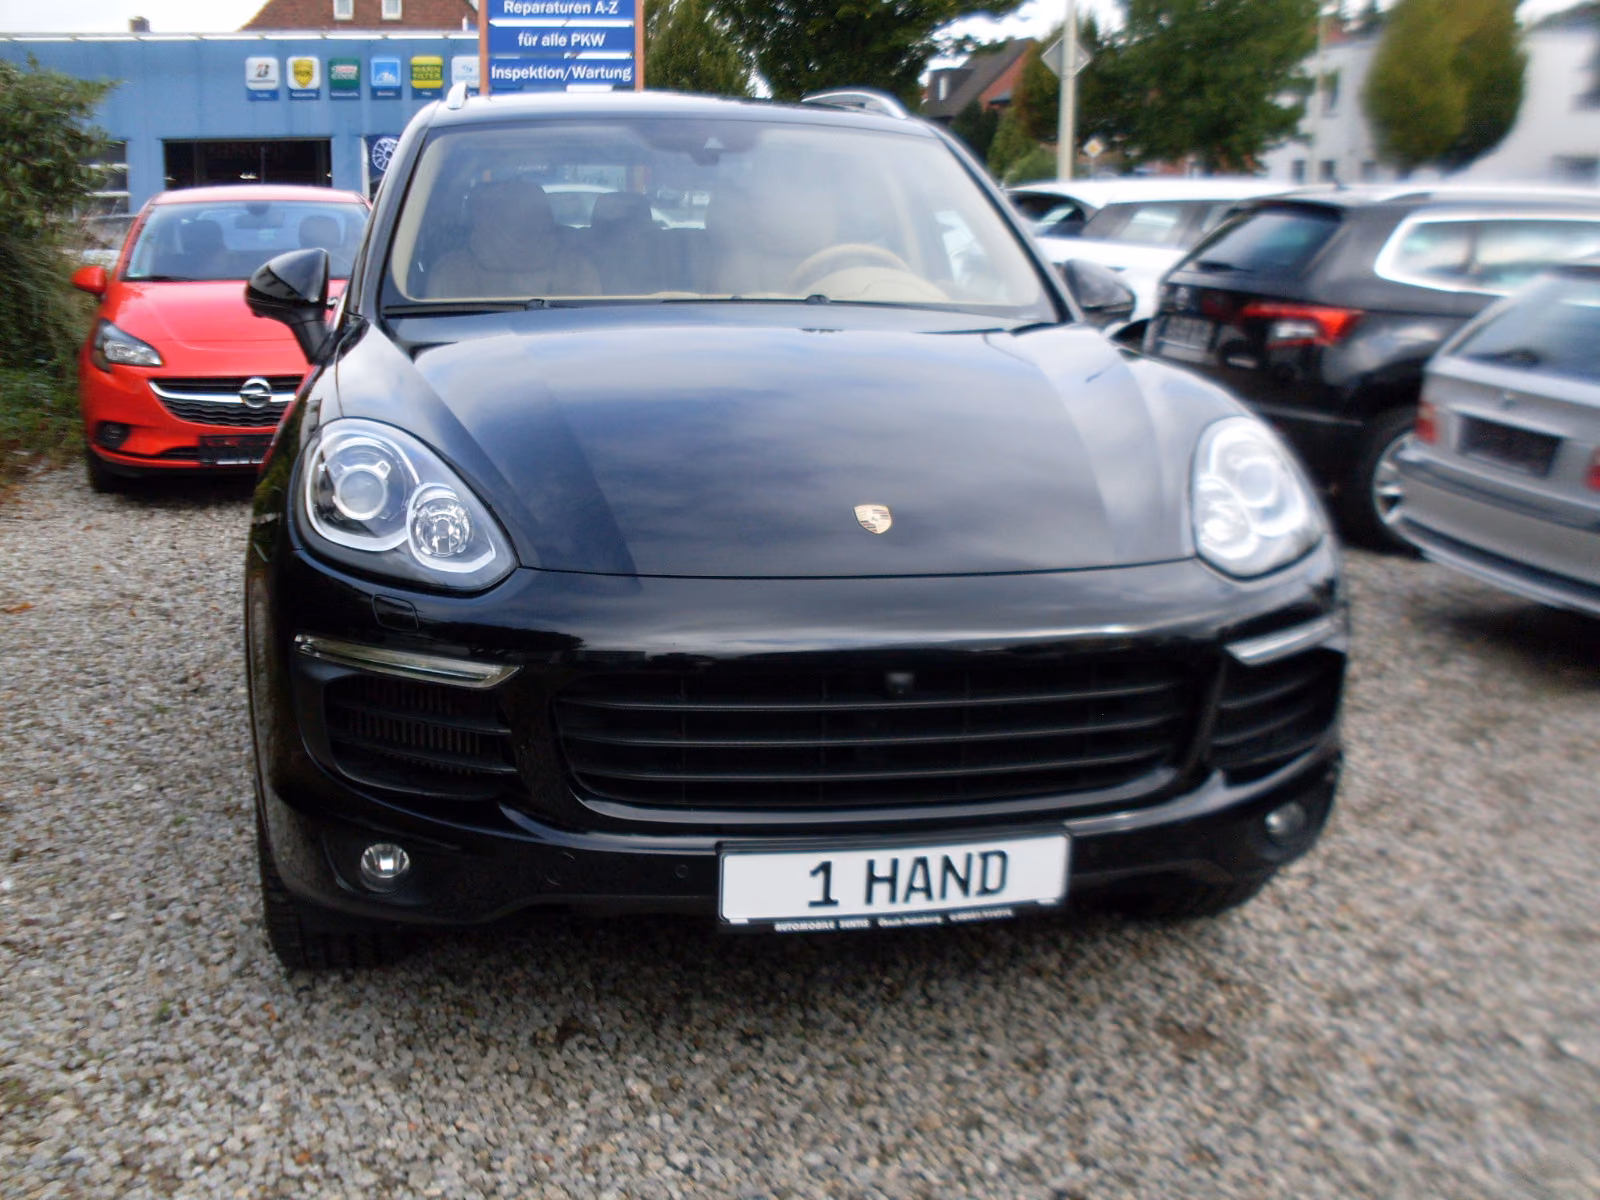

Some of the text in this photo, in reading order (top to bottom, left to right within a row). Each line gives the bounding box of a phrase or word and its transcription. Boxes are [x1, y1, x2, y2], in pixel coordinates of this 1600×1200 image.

[503, 0, 619, 16] Reparaturen A-Z
[517, 32, 606, 47] für alle PKW
[491, 64, 632, 82] Inspektion/Wartung
[808, 849, 1008, 908] 1 HAND
